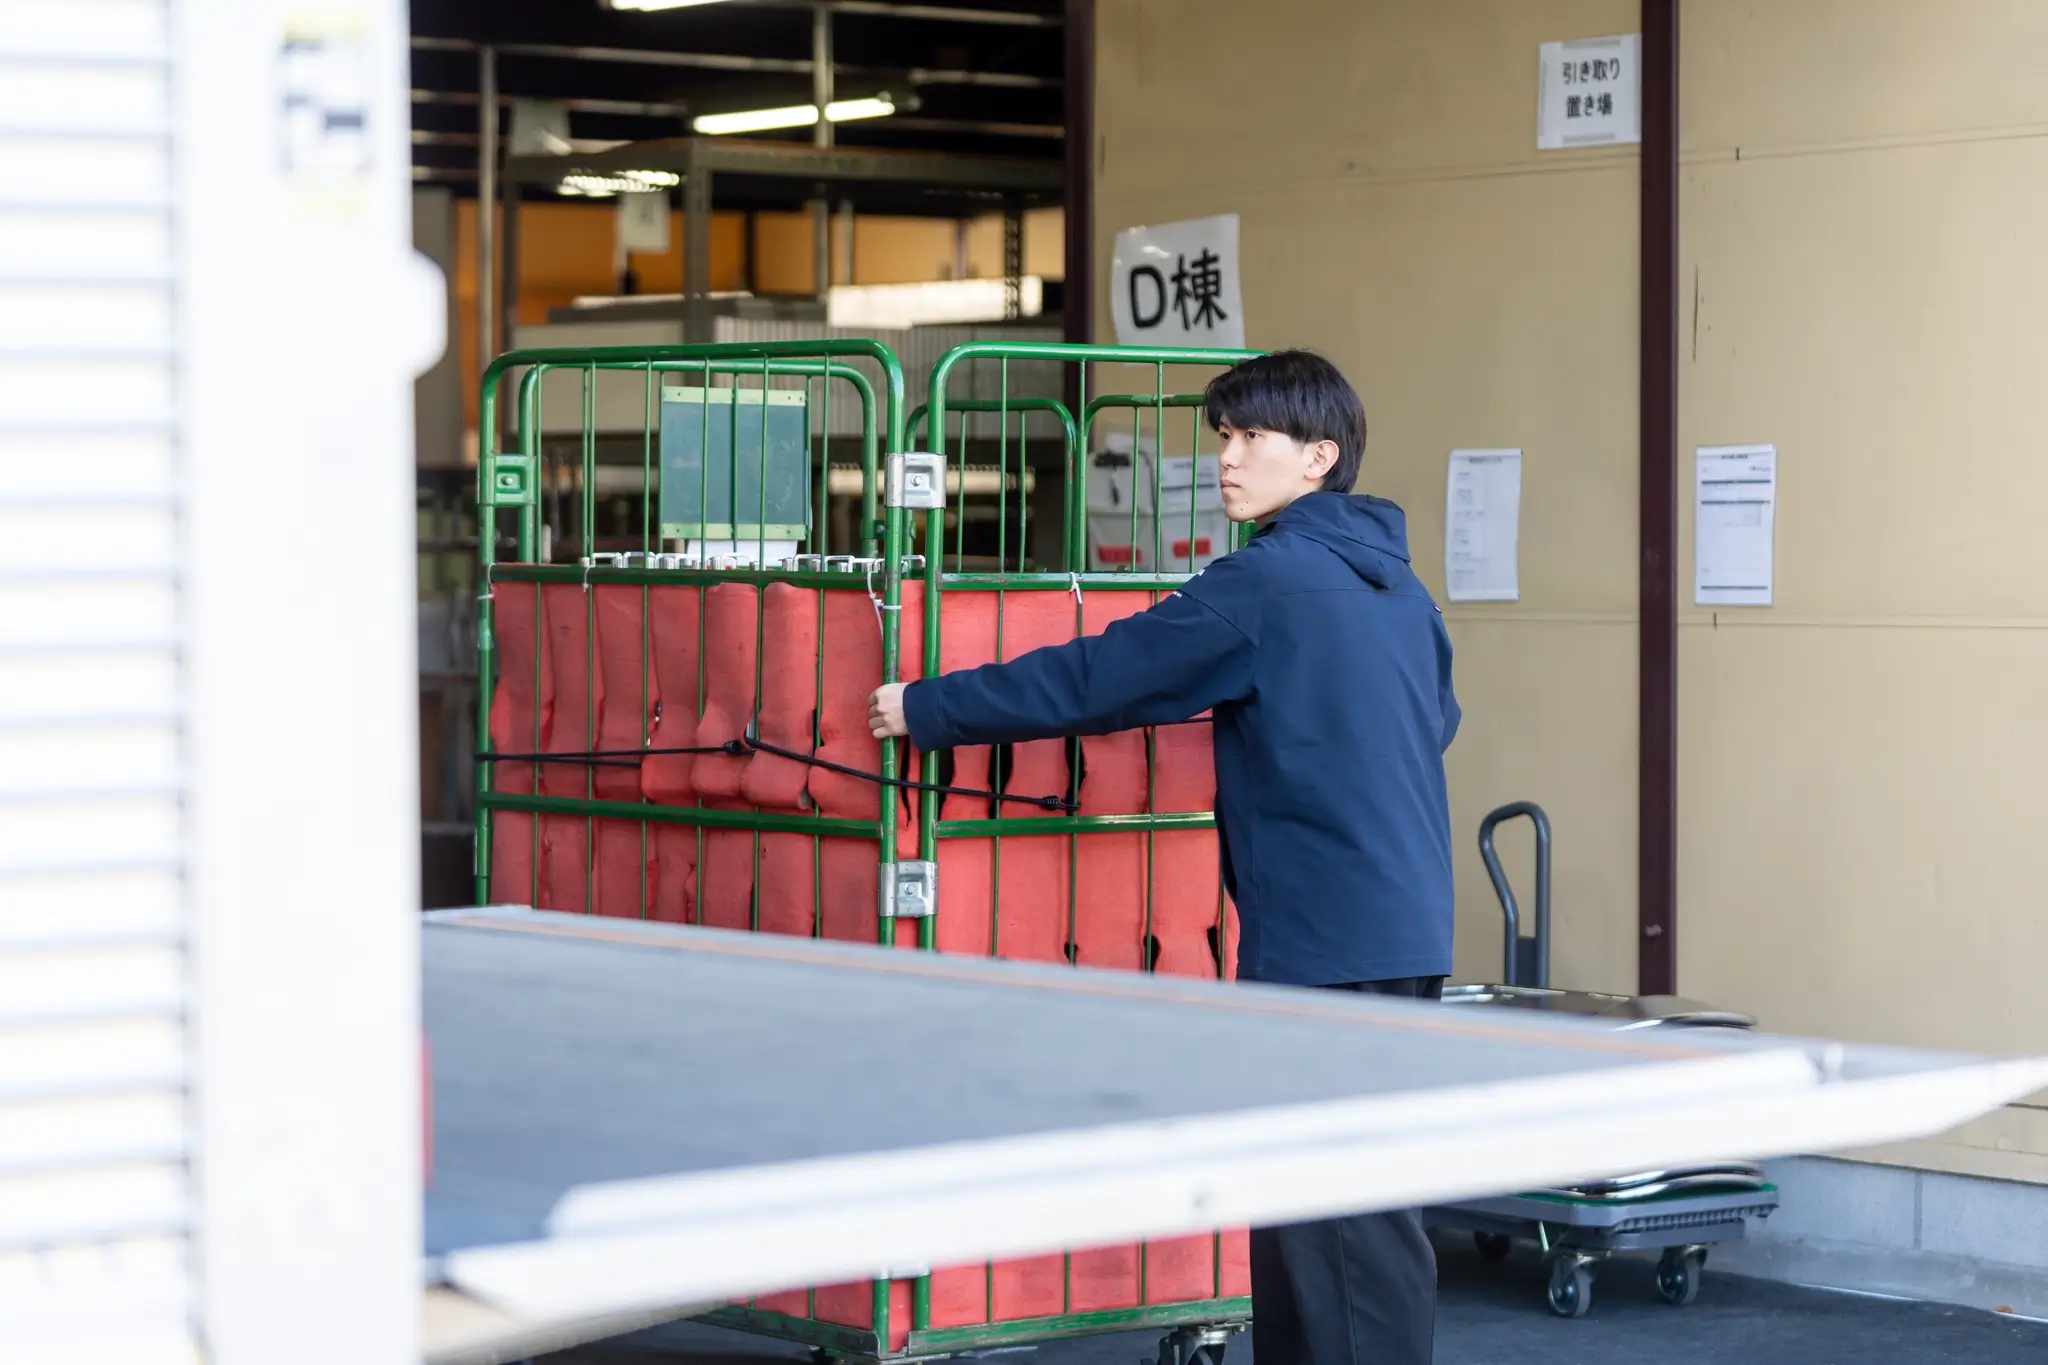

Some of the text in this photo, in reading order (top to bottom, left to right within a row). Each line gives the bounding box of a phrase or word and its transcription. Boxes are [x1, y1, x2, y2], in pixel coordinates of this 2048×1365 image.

[1562, 57, 1620, 85] 引き取り
[1566, 92, 1613, 118] 置き場
[1129, 248, 1228, 331] D棟
